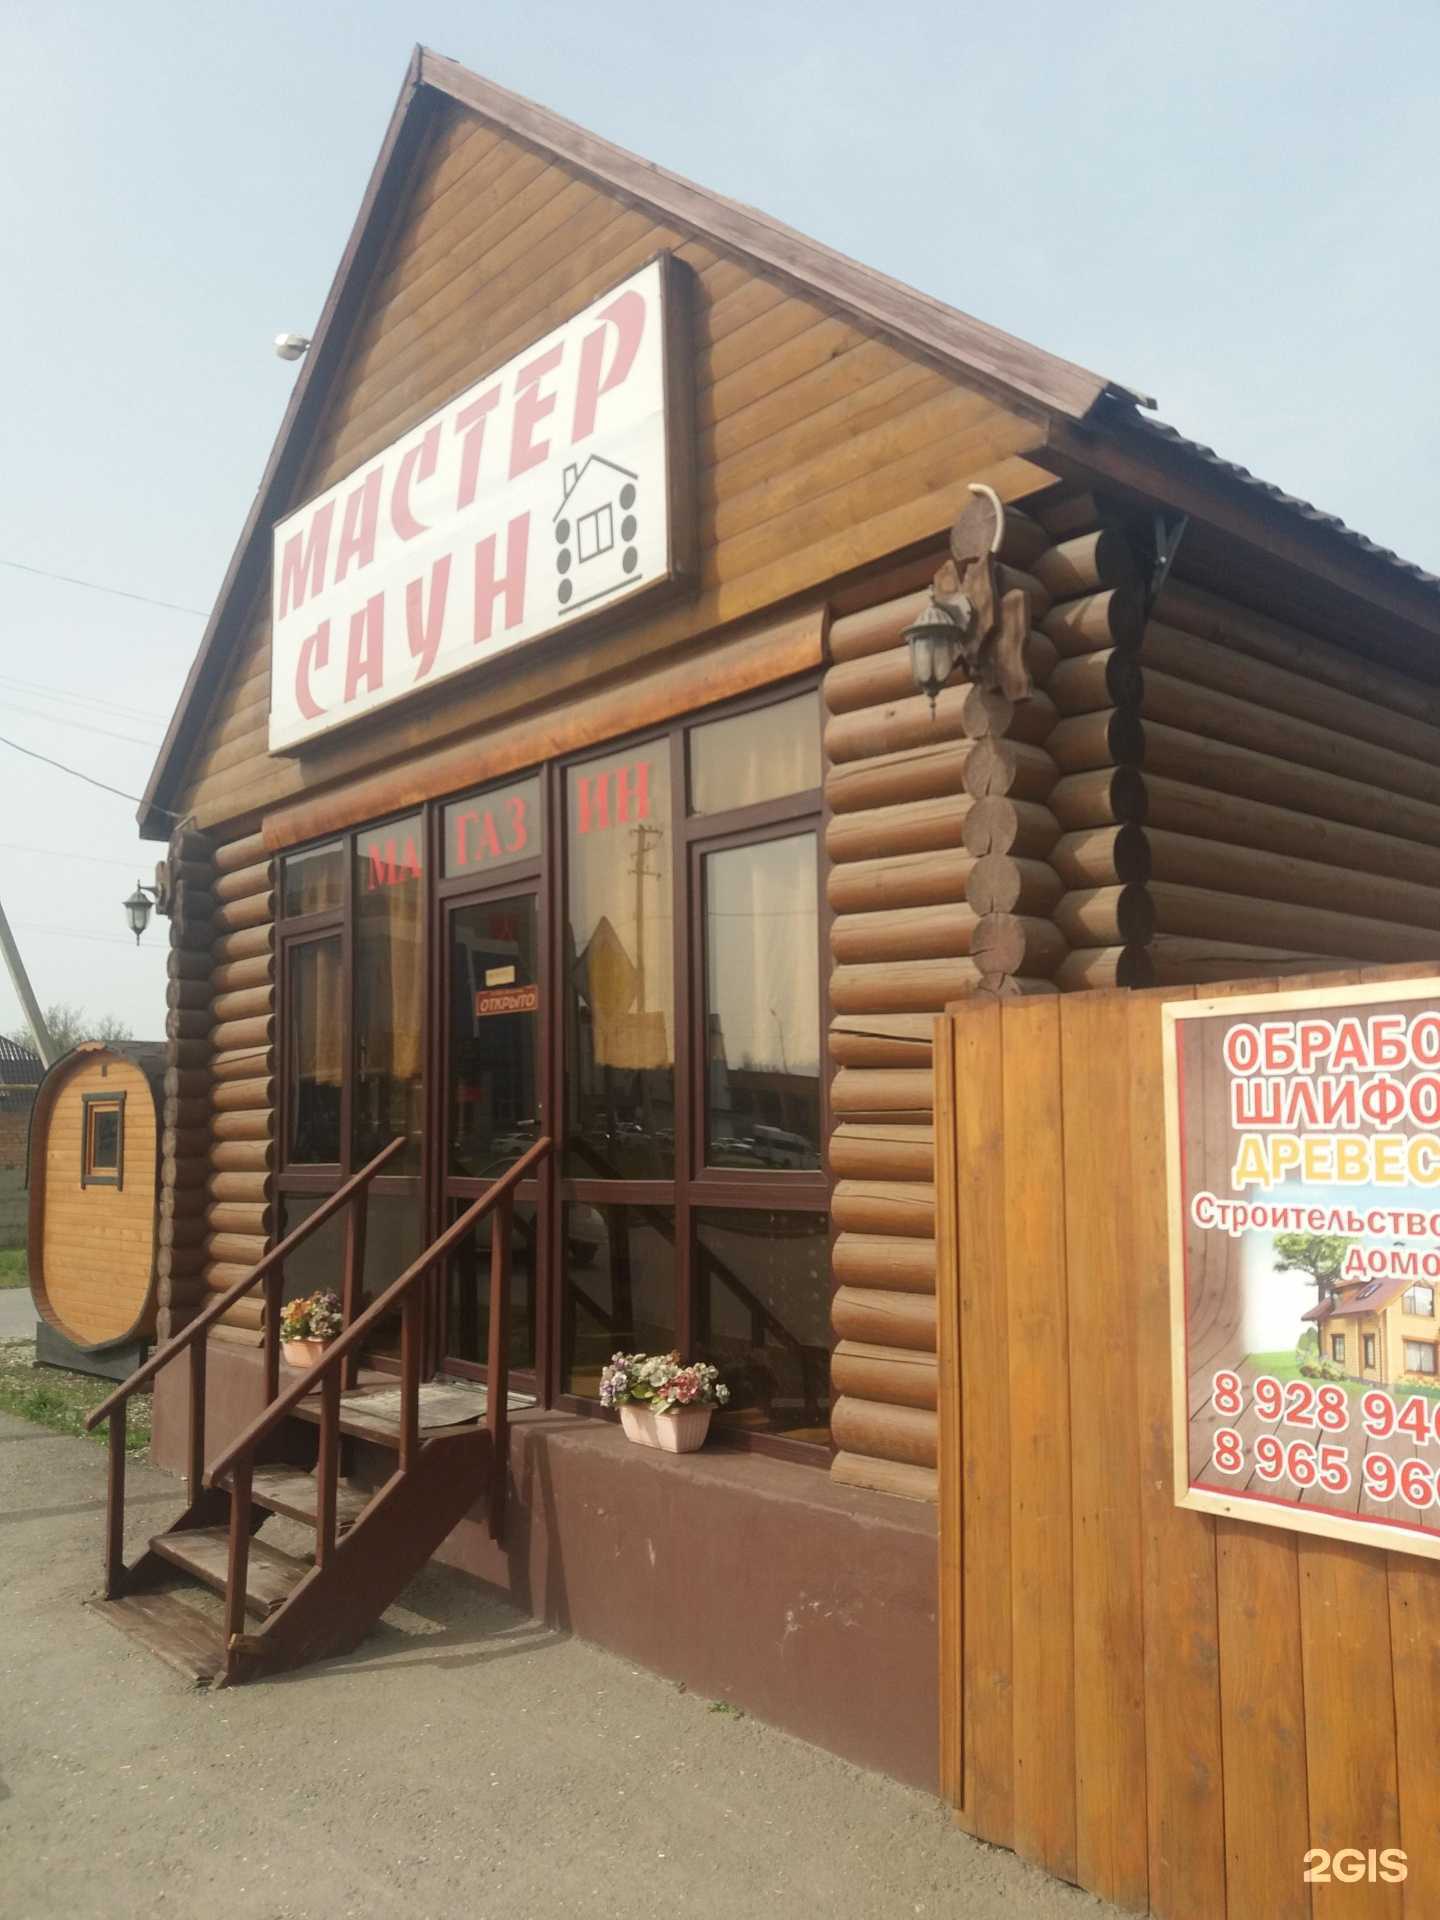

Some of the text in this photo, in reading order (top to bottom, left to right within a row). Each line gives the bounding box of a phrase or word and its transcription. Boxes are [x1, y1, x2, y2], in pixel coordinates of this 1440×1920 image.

[278, 289, 647, 622] МАСТЕР
[295, 510, 531, 721] САУН
[367, 760, 652, 891] МА ГАЗ ИН
[480, 993, 535, 1012] ОТКРЫТО
[1225, 1014, 1440, 1073] ОБРАБО
[1233, 1074, 1440, 1127] ШЛИФО
[1234, 1135, 1440, 1188] ДРЕВЕС
[1343, 1247, 1440, 1279] домо
[1214, 1372, 1440, 1443] 8 928 94
[1214, 1429, 1440, 1507] 8 965 96
